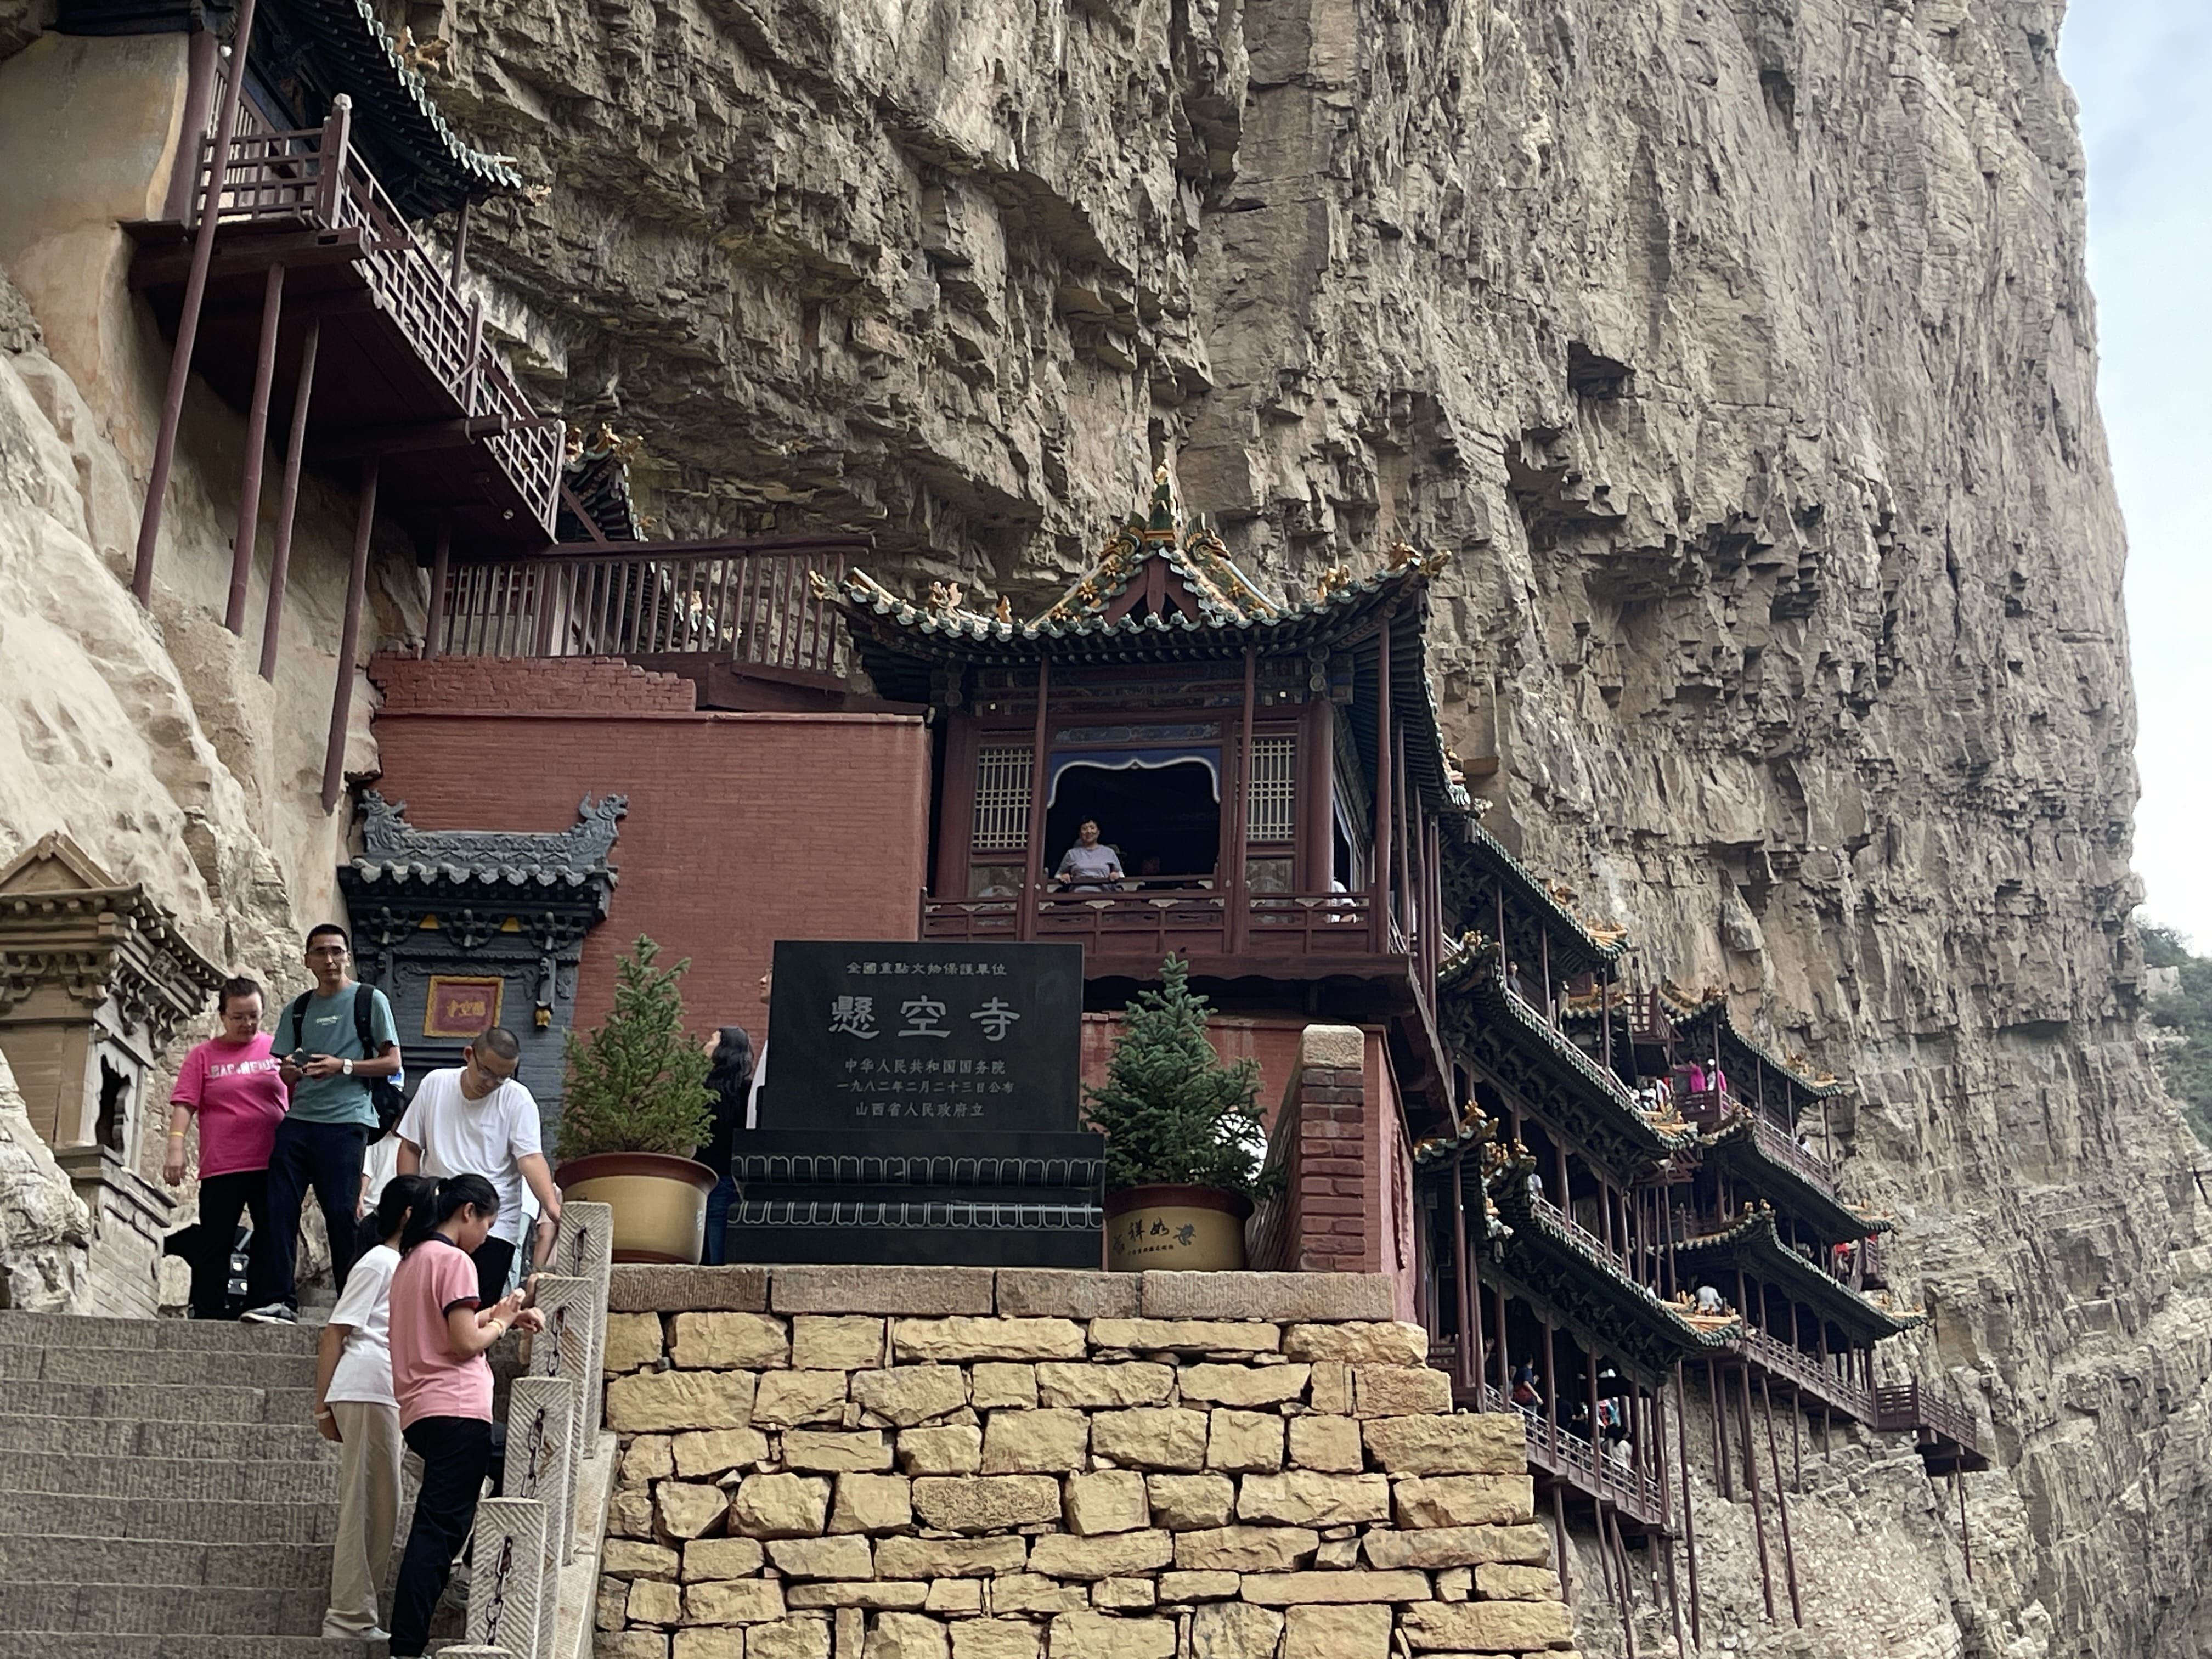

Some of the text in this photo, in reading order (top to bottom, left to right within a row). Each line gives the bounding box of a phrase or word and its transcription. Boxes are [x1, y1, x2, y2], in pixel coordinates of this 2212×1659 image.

[846, 962, 1007, 975] 全國重點文物保護單位
[828, 995, 1020, 1041] 懸空寺
[844, 1058, 1006, 1075] 中华人民共和国国务院
[837, 1080, 1014, 1093] 一九八二年二月二十三日公布
[855, 1101, 985, 1118] 山西省人民政府立
